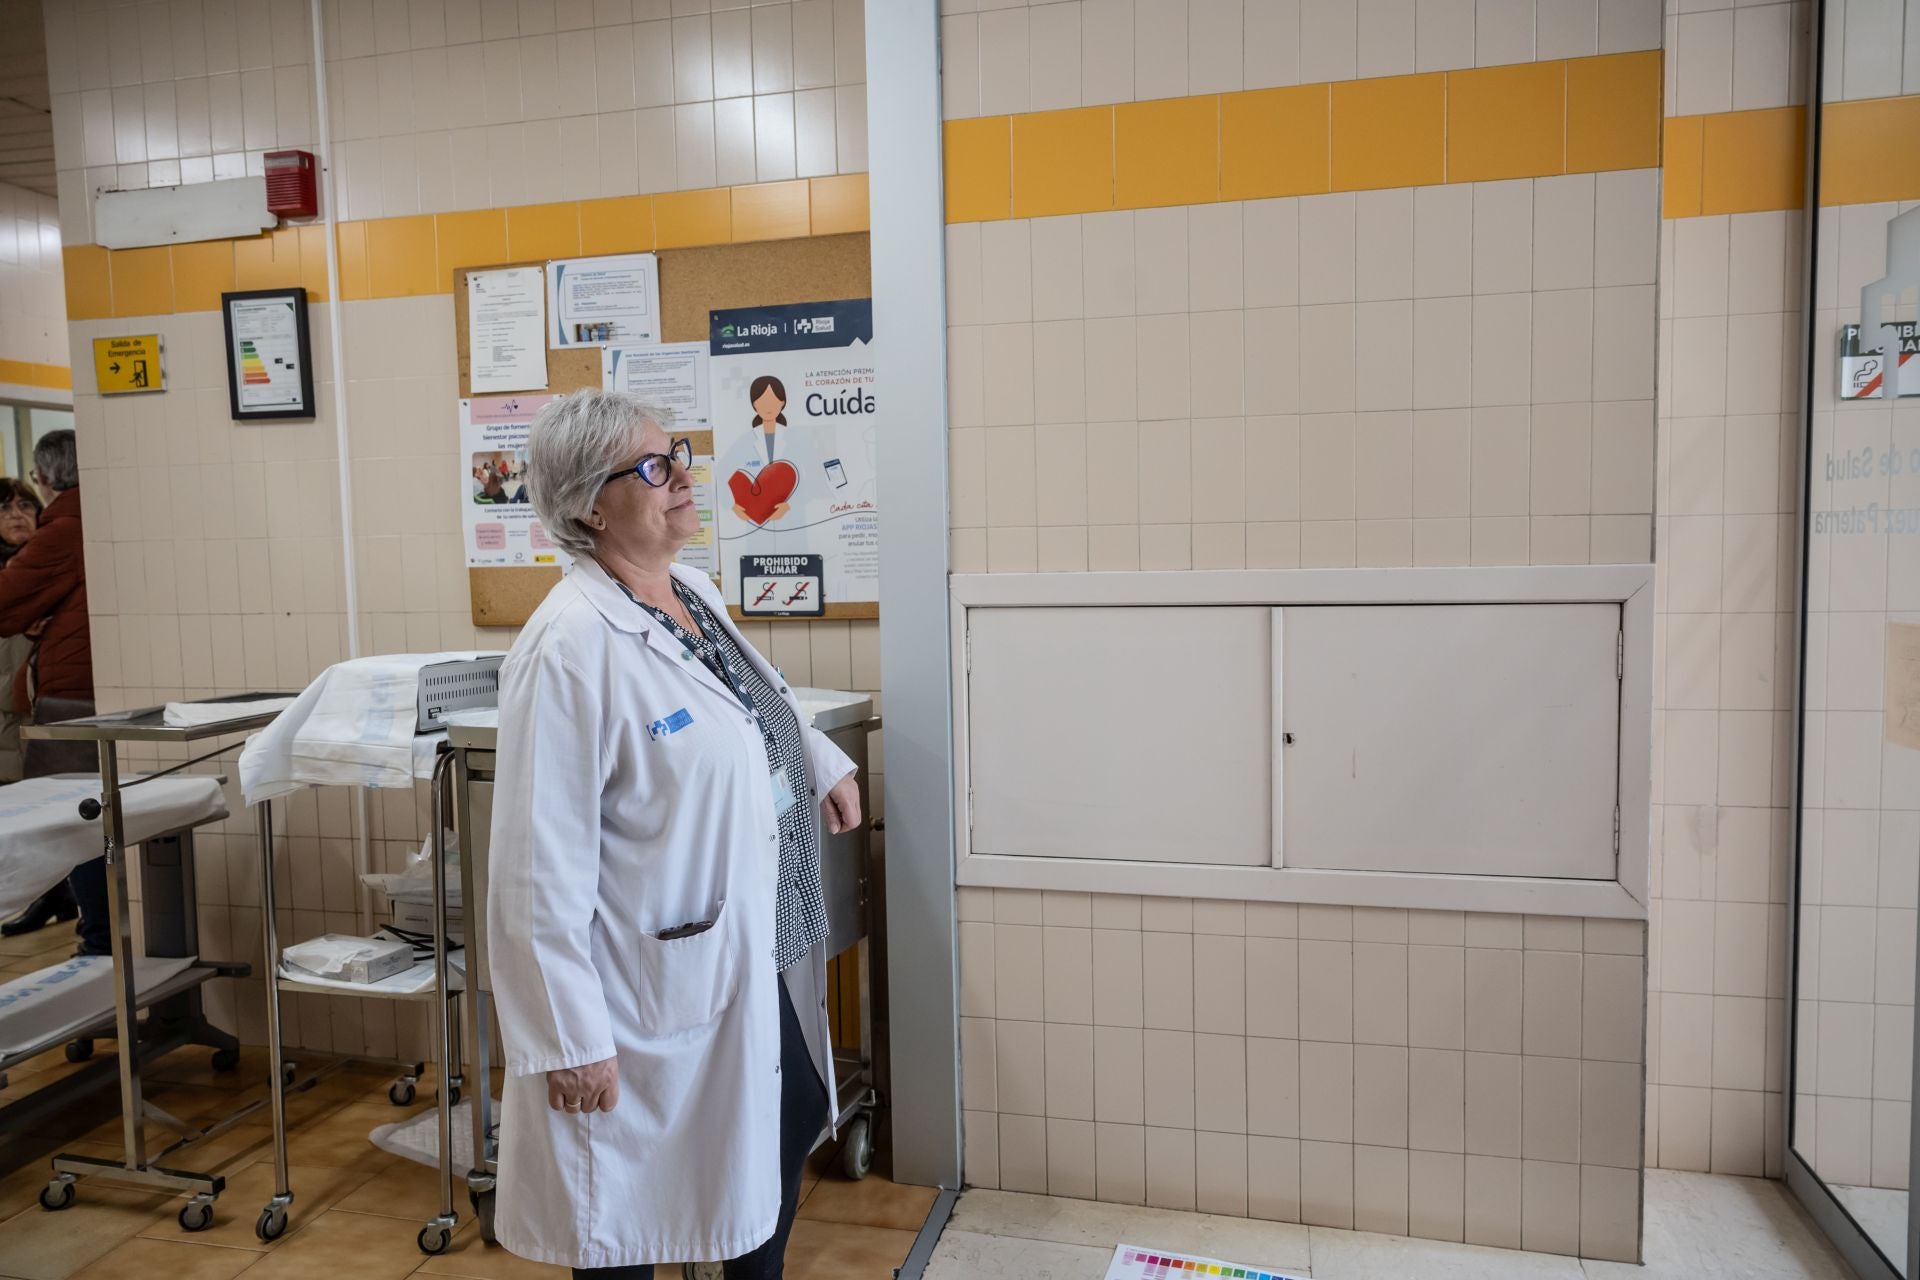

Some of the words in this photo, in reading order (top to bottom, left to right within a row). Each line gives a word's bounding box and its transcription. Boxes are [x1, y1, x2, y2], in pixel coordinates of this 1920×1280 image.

[737, 326, 749, 337] La
[750, 323, 778, 337] Rioja
[111, 340, 130, 348] Salida
[133, 339, 142, 347] de
[108, 349, 146, 358] Emergencia
[815, 369, 851, 377] ATENCIÓN
[815, 377, 851, 386] CORAZÓN
[753, 556, 808, 567] PROHIBIDO
[764, 565, 798, 574] FUMAR
